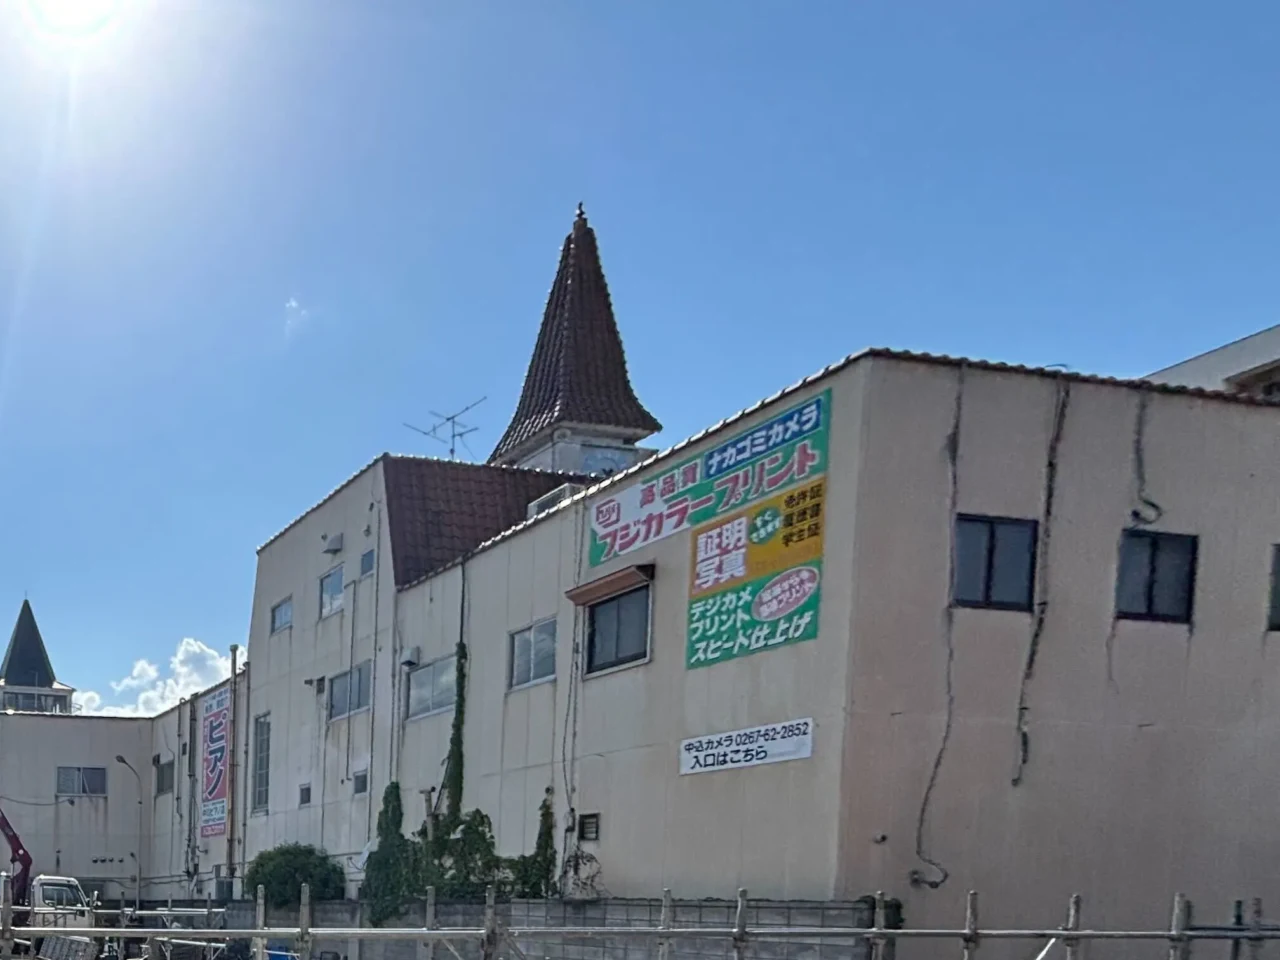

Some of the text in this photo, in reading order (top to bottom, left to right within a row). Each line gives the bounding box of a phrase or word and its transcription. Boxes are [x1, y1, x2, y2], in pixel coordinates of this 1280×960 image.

[707, 404, 819, 475] ナカゴミカメラ
[697, 516, 747, 558] 証明
[694, 548, 746, 590] 写真
[690, 586, 753, 620] デジカメ
[690, 607, 751, 641] プリント
[690, 610, 815, 663] スピード仕上げ
[208, 711, 228, 799] ピアノ
[735, 721, 809, 747] 0267-62-2852
[690, 745, 768, 770] 入口はこちら
